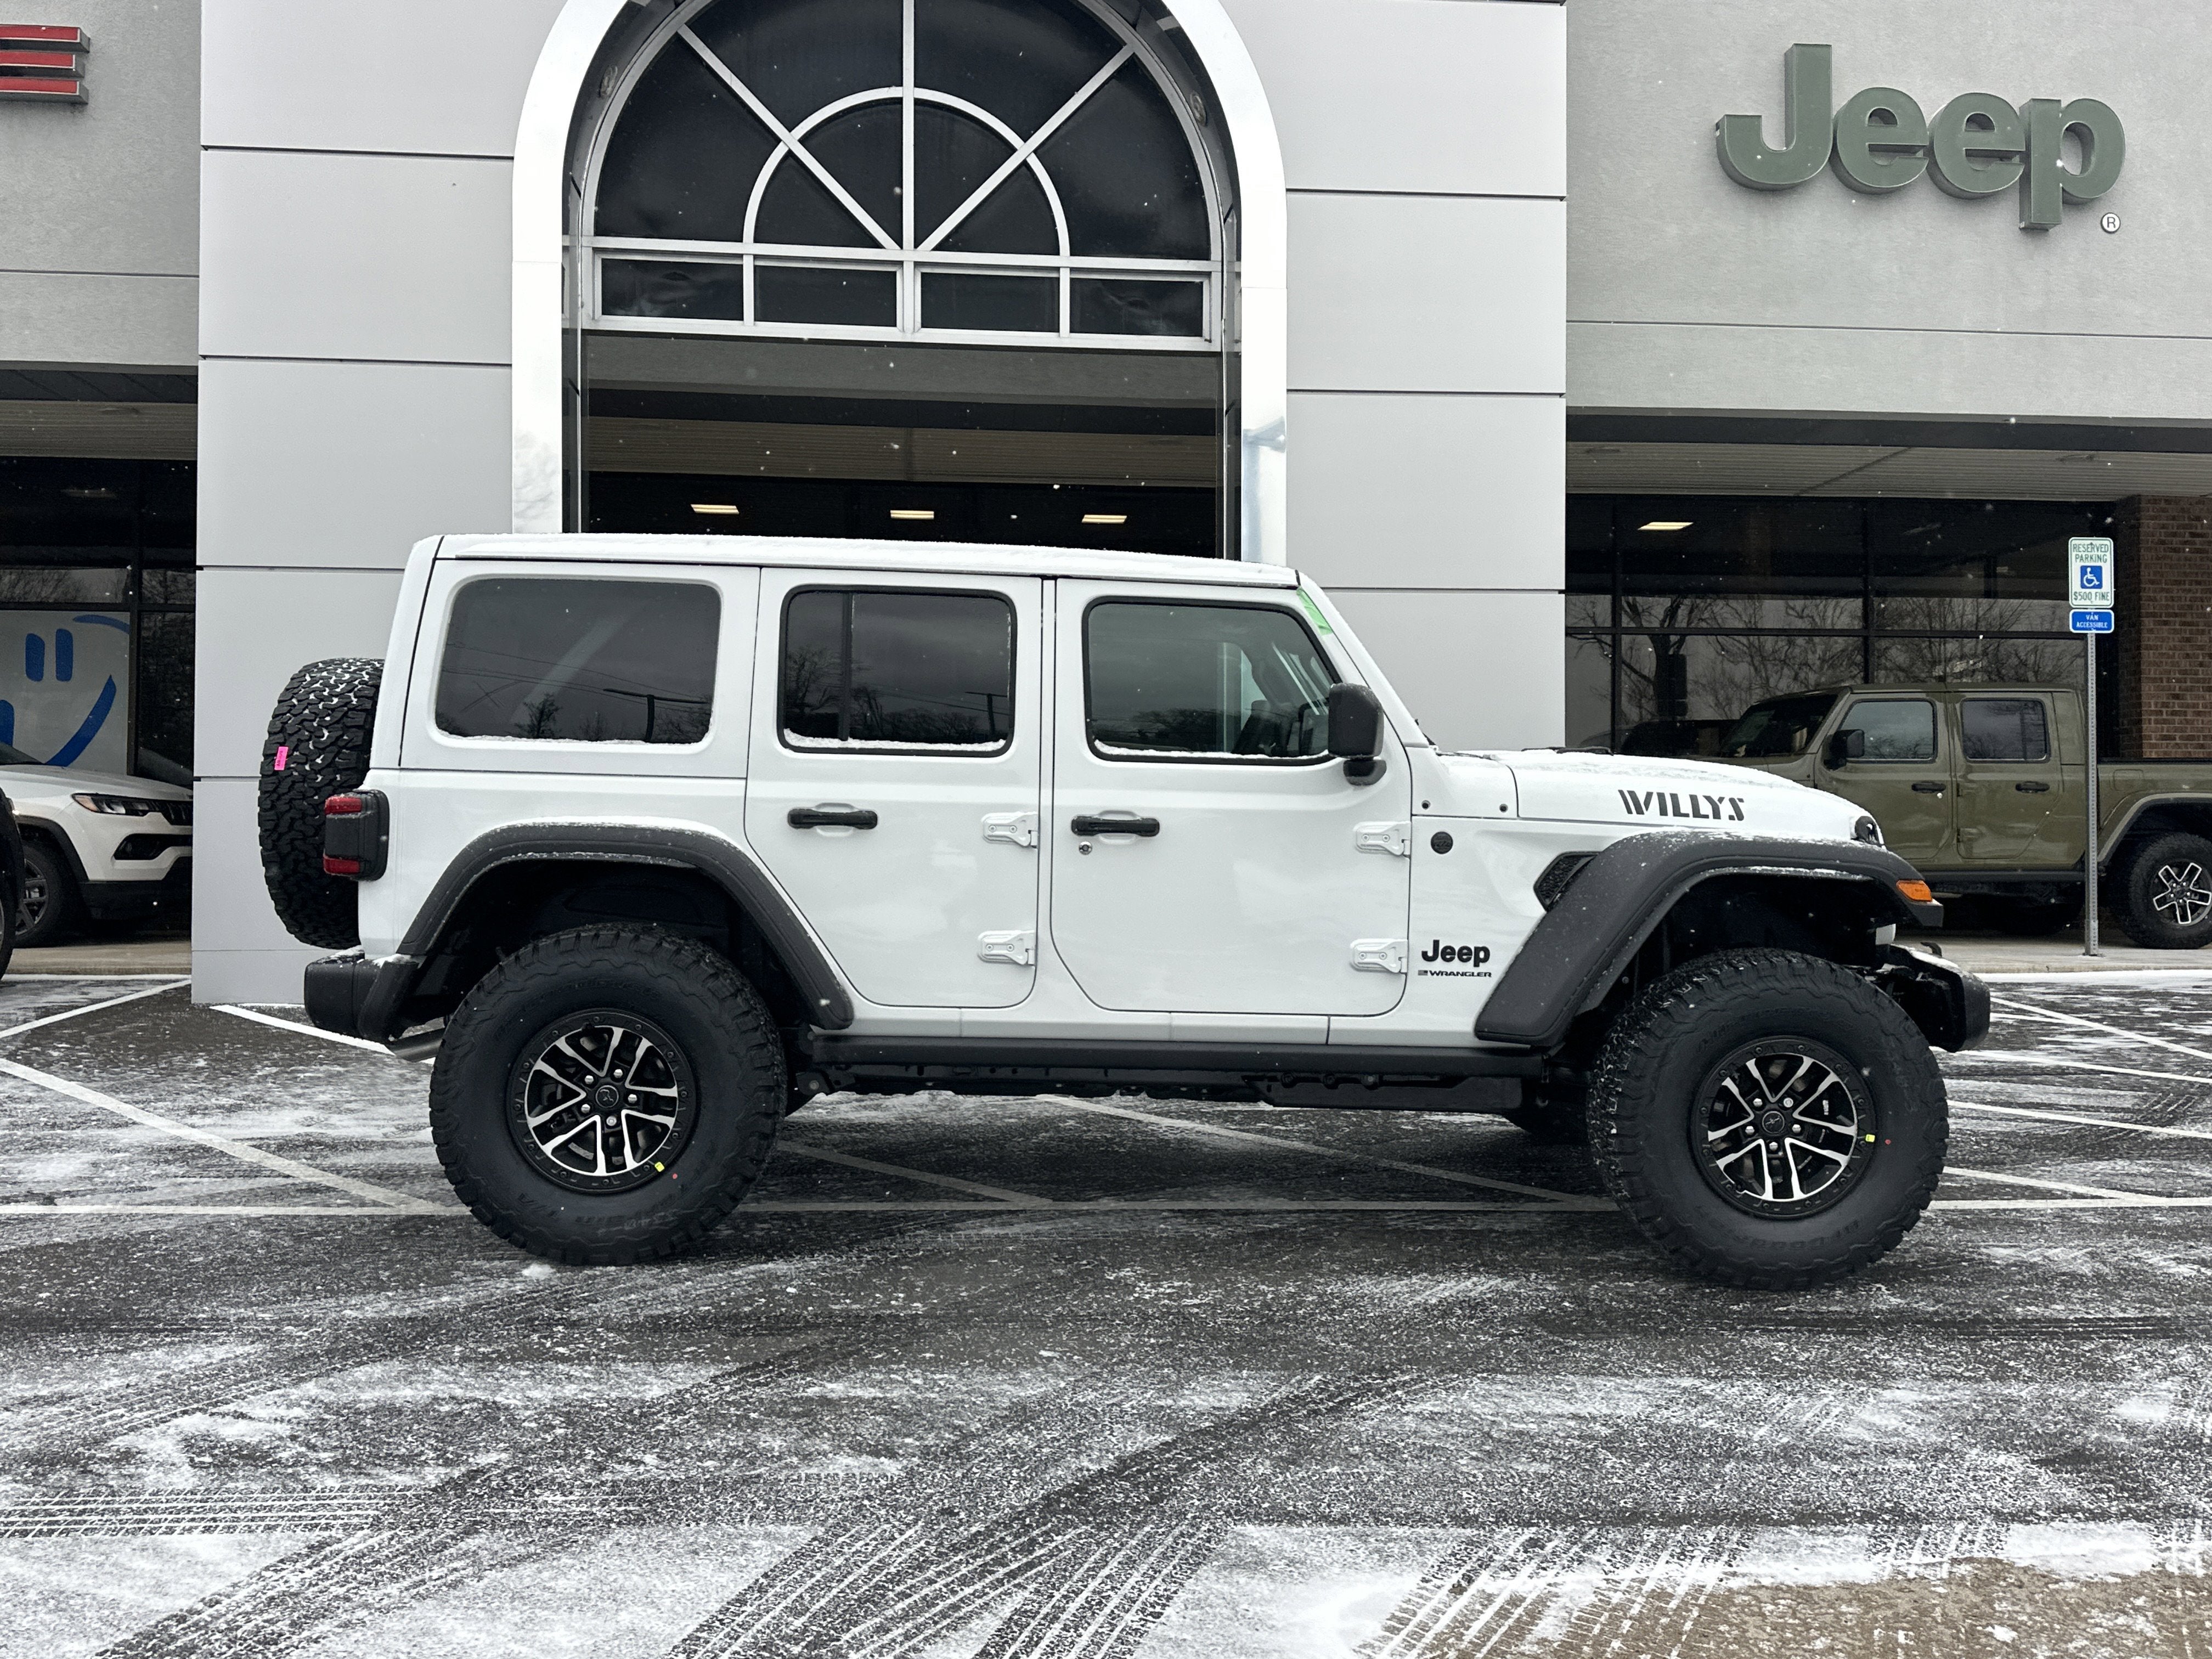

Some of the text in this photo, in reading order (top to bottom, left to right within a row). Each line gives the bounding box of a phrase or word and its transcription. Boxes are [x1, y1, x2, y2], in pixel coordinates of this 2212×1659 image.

[1716, 43, 2126, 231] Jeep
[2073, 543, 2109, 552] RESERVED
[2075, 554, 2107, 563] PARKING
[2074, 591, 2110, 601] $500 FINE
[1618, 789, 1744, 821] WILLYS
[1421, 939, 1491, 967] Jeep
